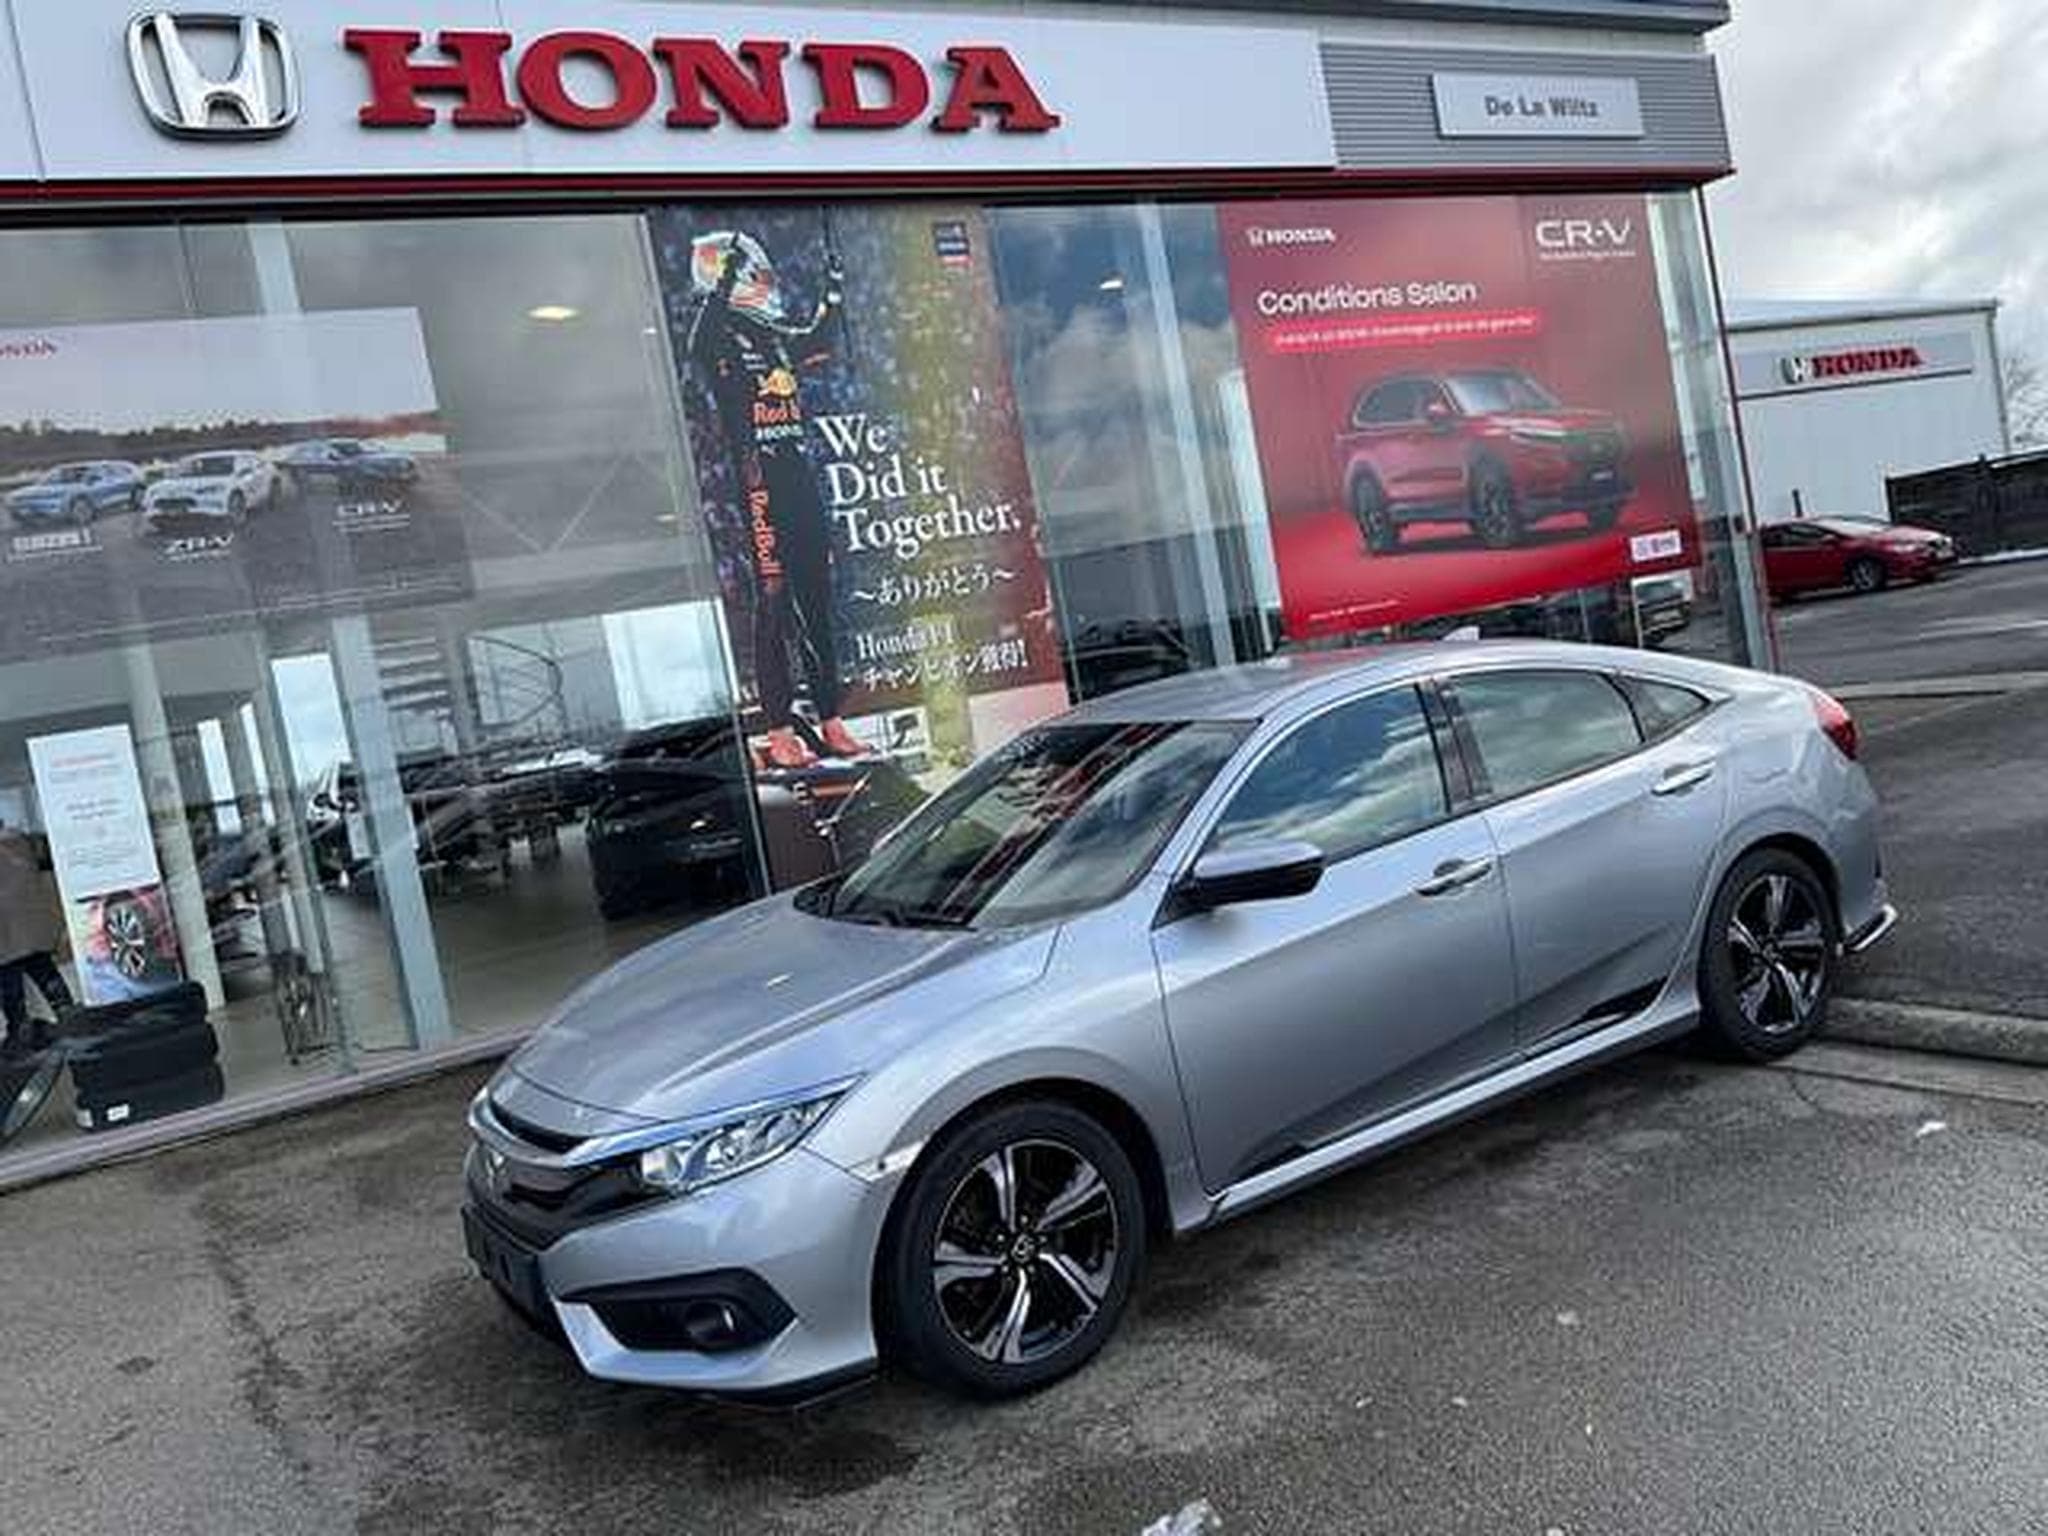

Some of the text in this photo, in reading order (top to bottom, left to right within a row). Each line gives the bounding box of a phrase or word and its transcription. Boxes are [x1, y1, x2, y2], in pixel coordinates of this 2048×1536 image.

[344, 29, 1061, 132] HONDA
[1484, 95, 1514, 117] De
[1519, 96, 1545, 118] La
[1257, 281, 1477, 316] Conditions Salon
[1811, 347, 1924, 379] HONDA
[815, 413, 888, 457] We
[825, 454, 948, 507] Did it
[833, 492, 1022, 560] Together.
